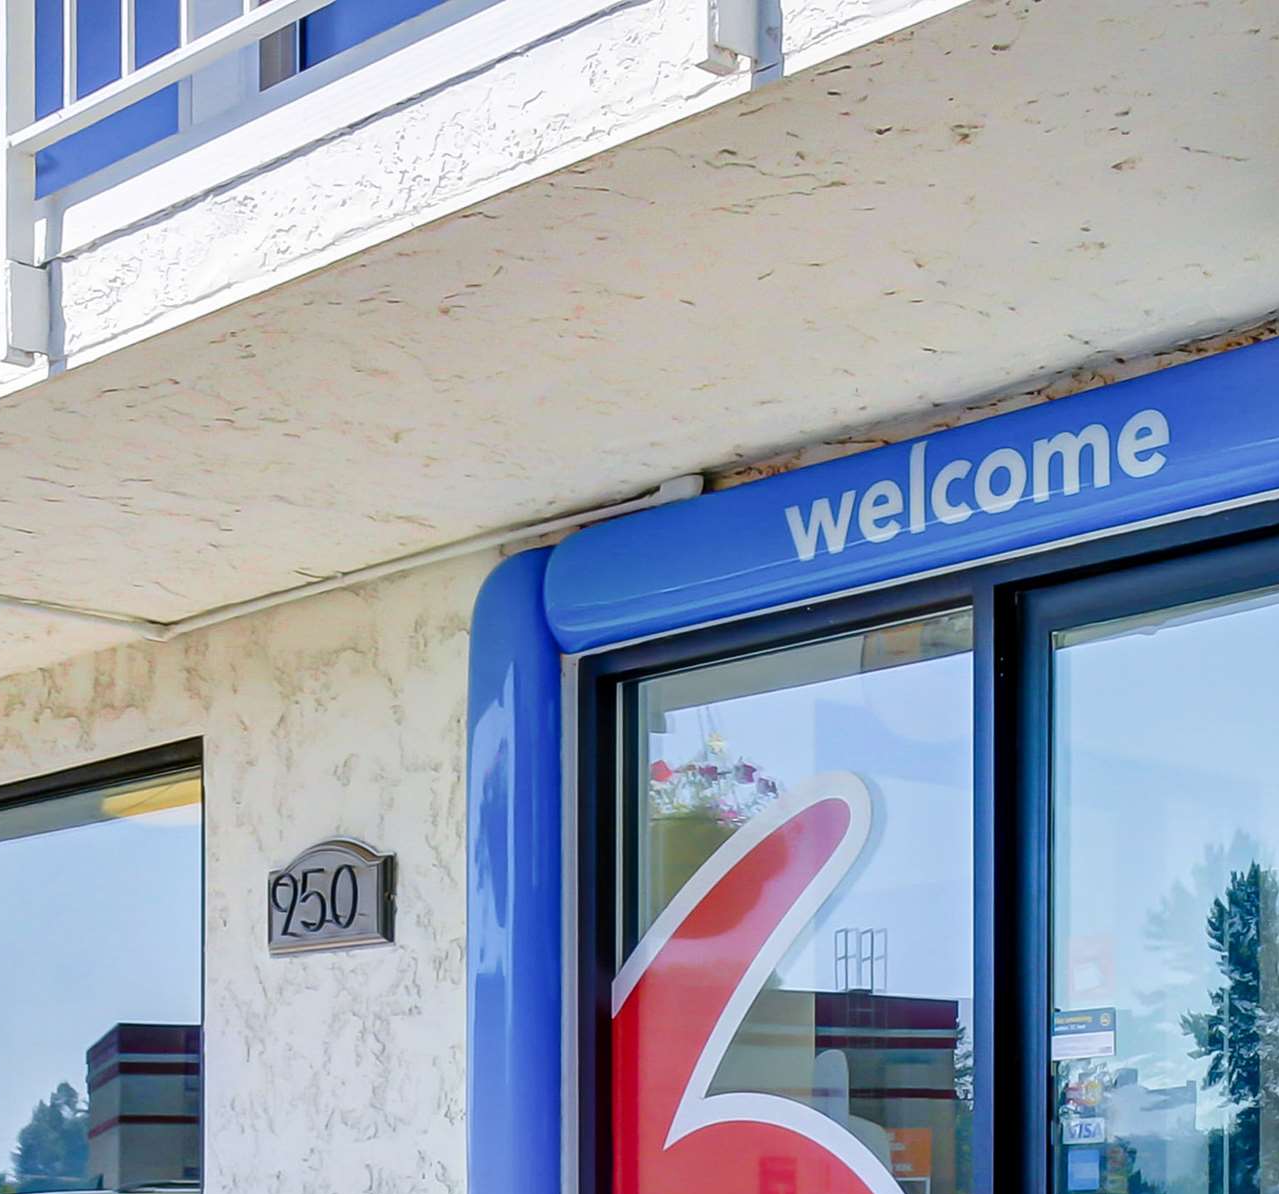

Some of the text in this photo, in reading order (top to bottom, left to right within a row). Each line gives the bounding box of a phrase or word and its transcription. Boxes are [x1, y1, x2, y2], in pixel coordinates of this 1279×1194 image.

[784, 408, 1171, 562] welcome
[271, 863, 358, 938] 950
[1069, 1122, 1102, 1139] VISA
